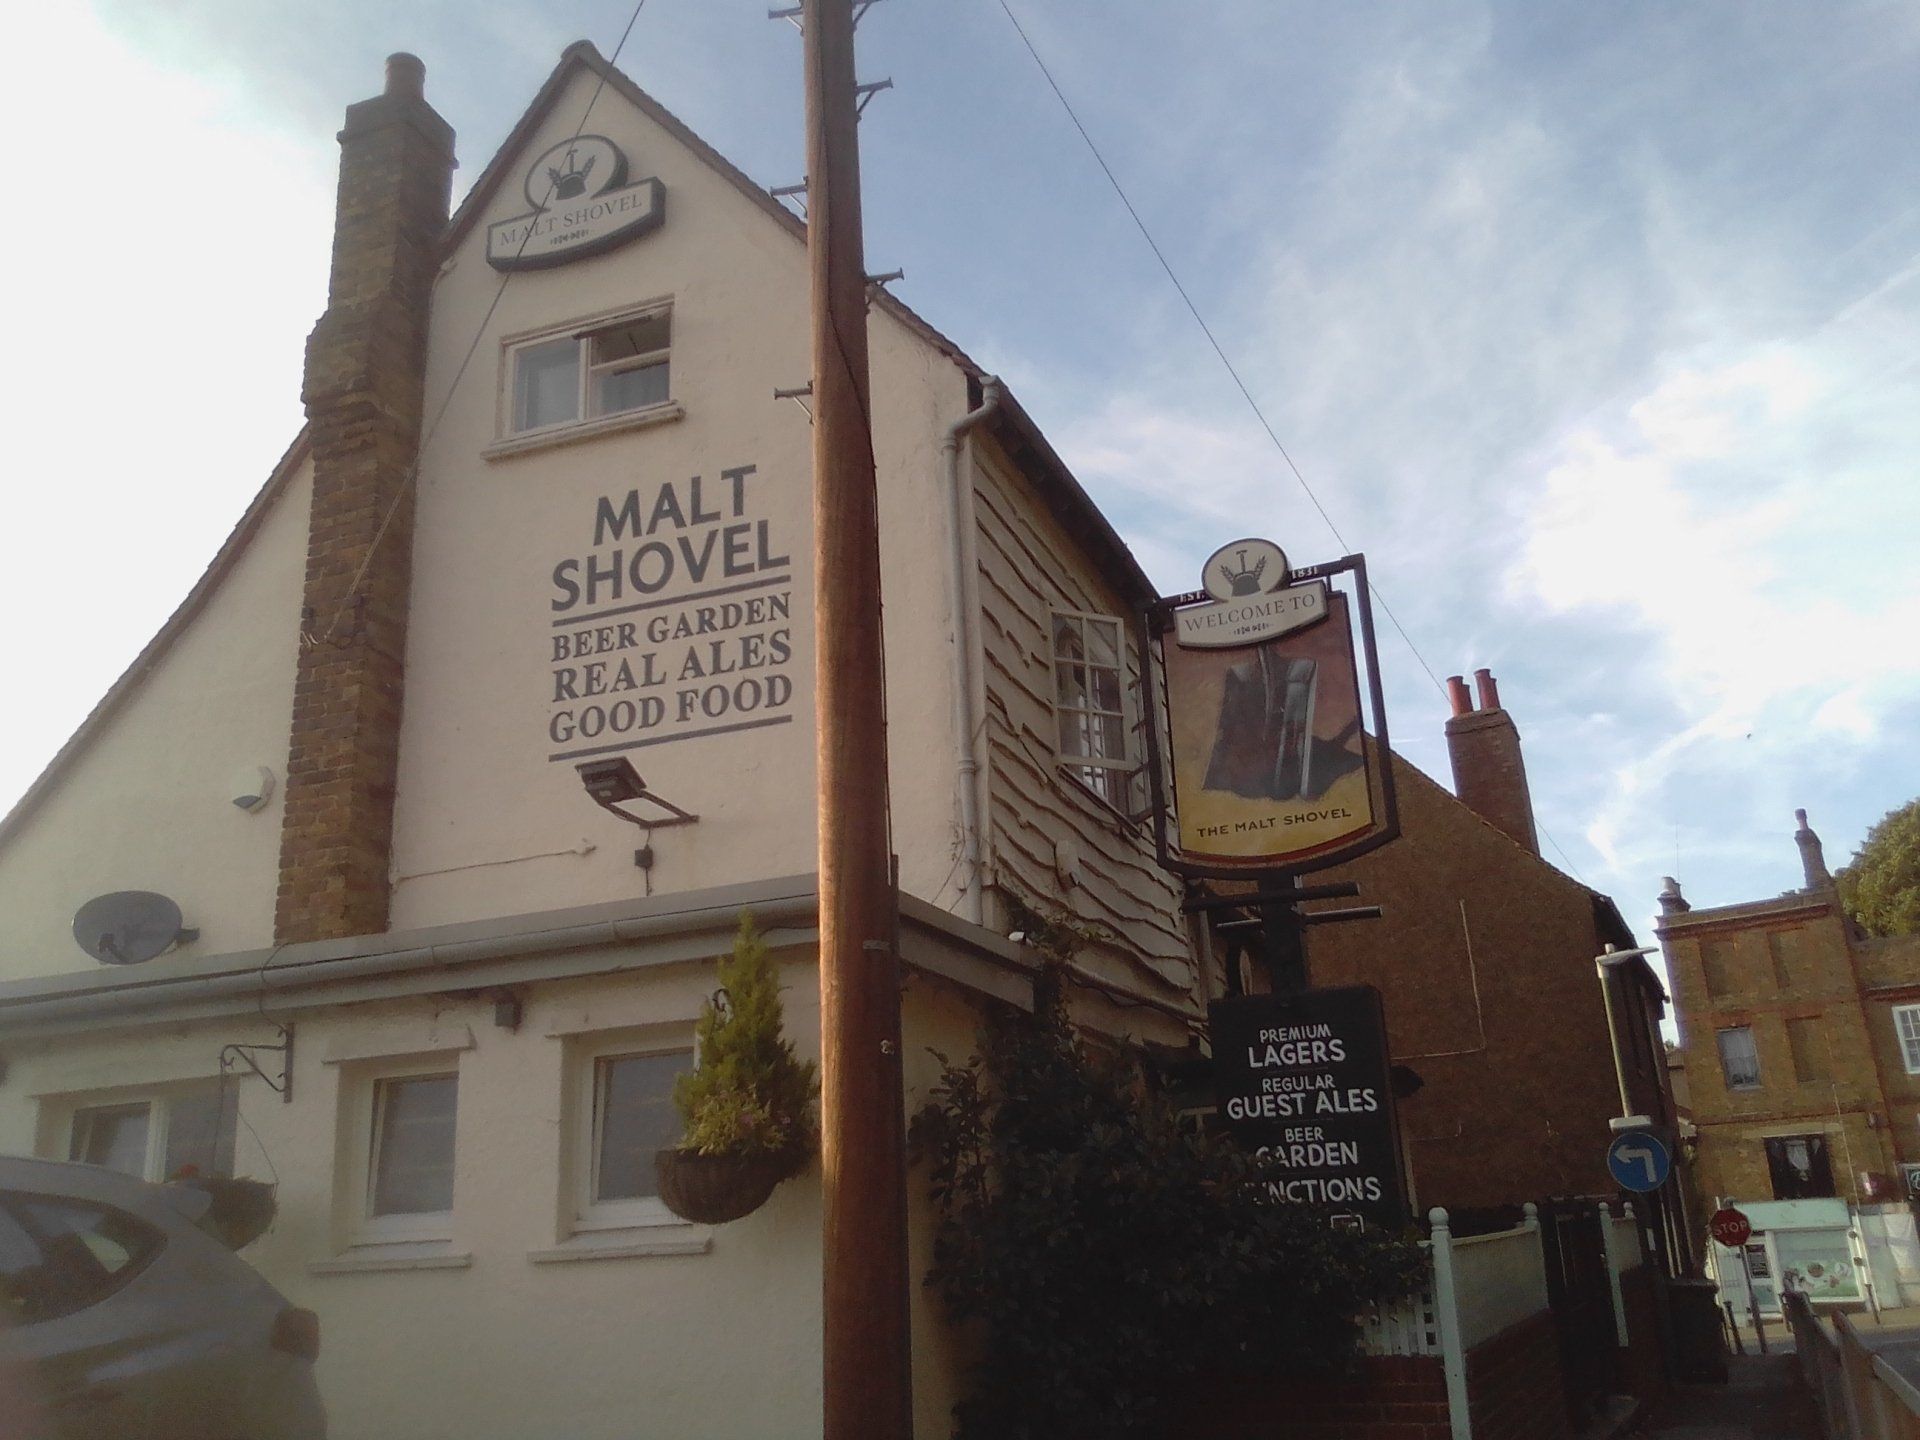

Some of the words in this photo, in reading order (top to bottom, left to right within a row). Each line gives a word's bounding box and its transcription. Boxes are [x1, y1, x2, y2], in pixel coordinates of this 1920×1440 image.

[500, 217, 558, 246] MALT
[563, 194, 643, 228] SHOVEL
[593, 464, 757, 546] MALT
[552, 519, 790, 611] SHOVEL
[551, 622, 639, 662] BEER
[647, 592, 791, 643] GARDEN
[1184, 602, 1285, 632] WELCOME
[1289, 593, 1315, 610] TO
[552, 653, 667, 703] REAL
[678, 628, 792, 681] ALES
[550, 696, 665, 744] GOOD
[676, 673, 792, 723] FOOD
[1197, 825, 1229, 838] THE
[1235, 818, 1276, 833] MALT
[1284, 808, 1352, 825] SHOVEL
[1259, 1023, 1332, 1044] PREMIUM
[1248, 1039, 1347, 1069] LAGERS
[1262, 1074, 1336, 1093] REGULAR
[1227, 1093, 1306, 1120] GUEST
[1315, 1088, 1378, 1114] ALES
[1285, 1126, 1325, 1142] BEER
[1712, 1220, 1747, 1236] STOP
